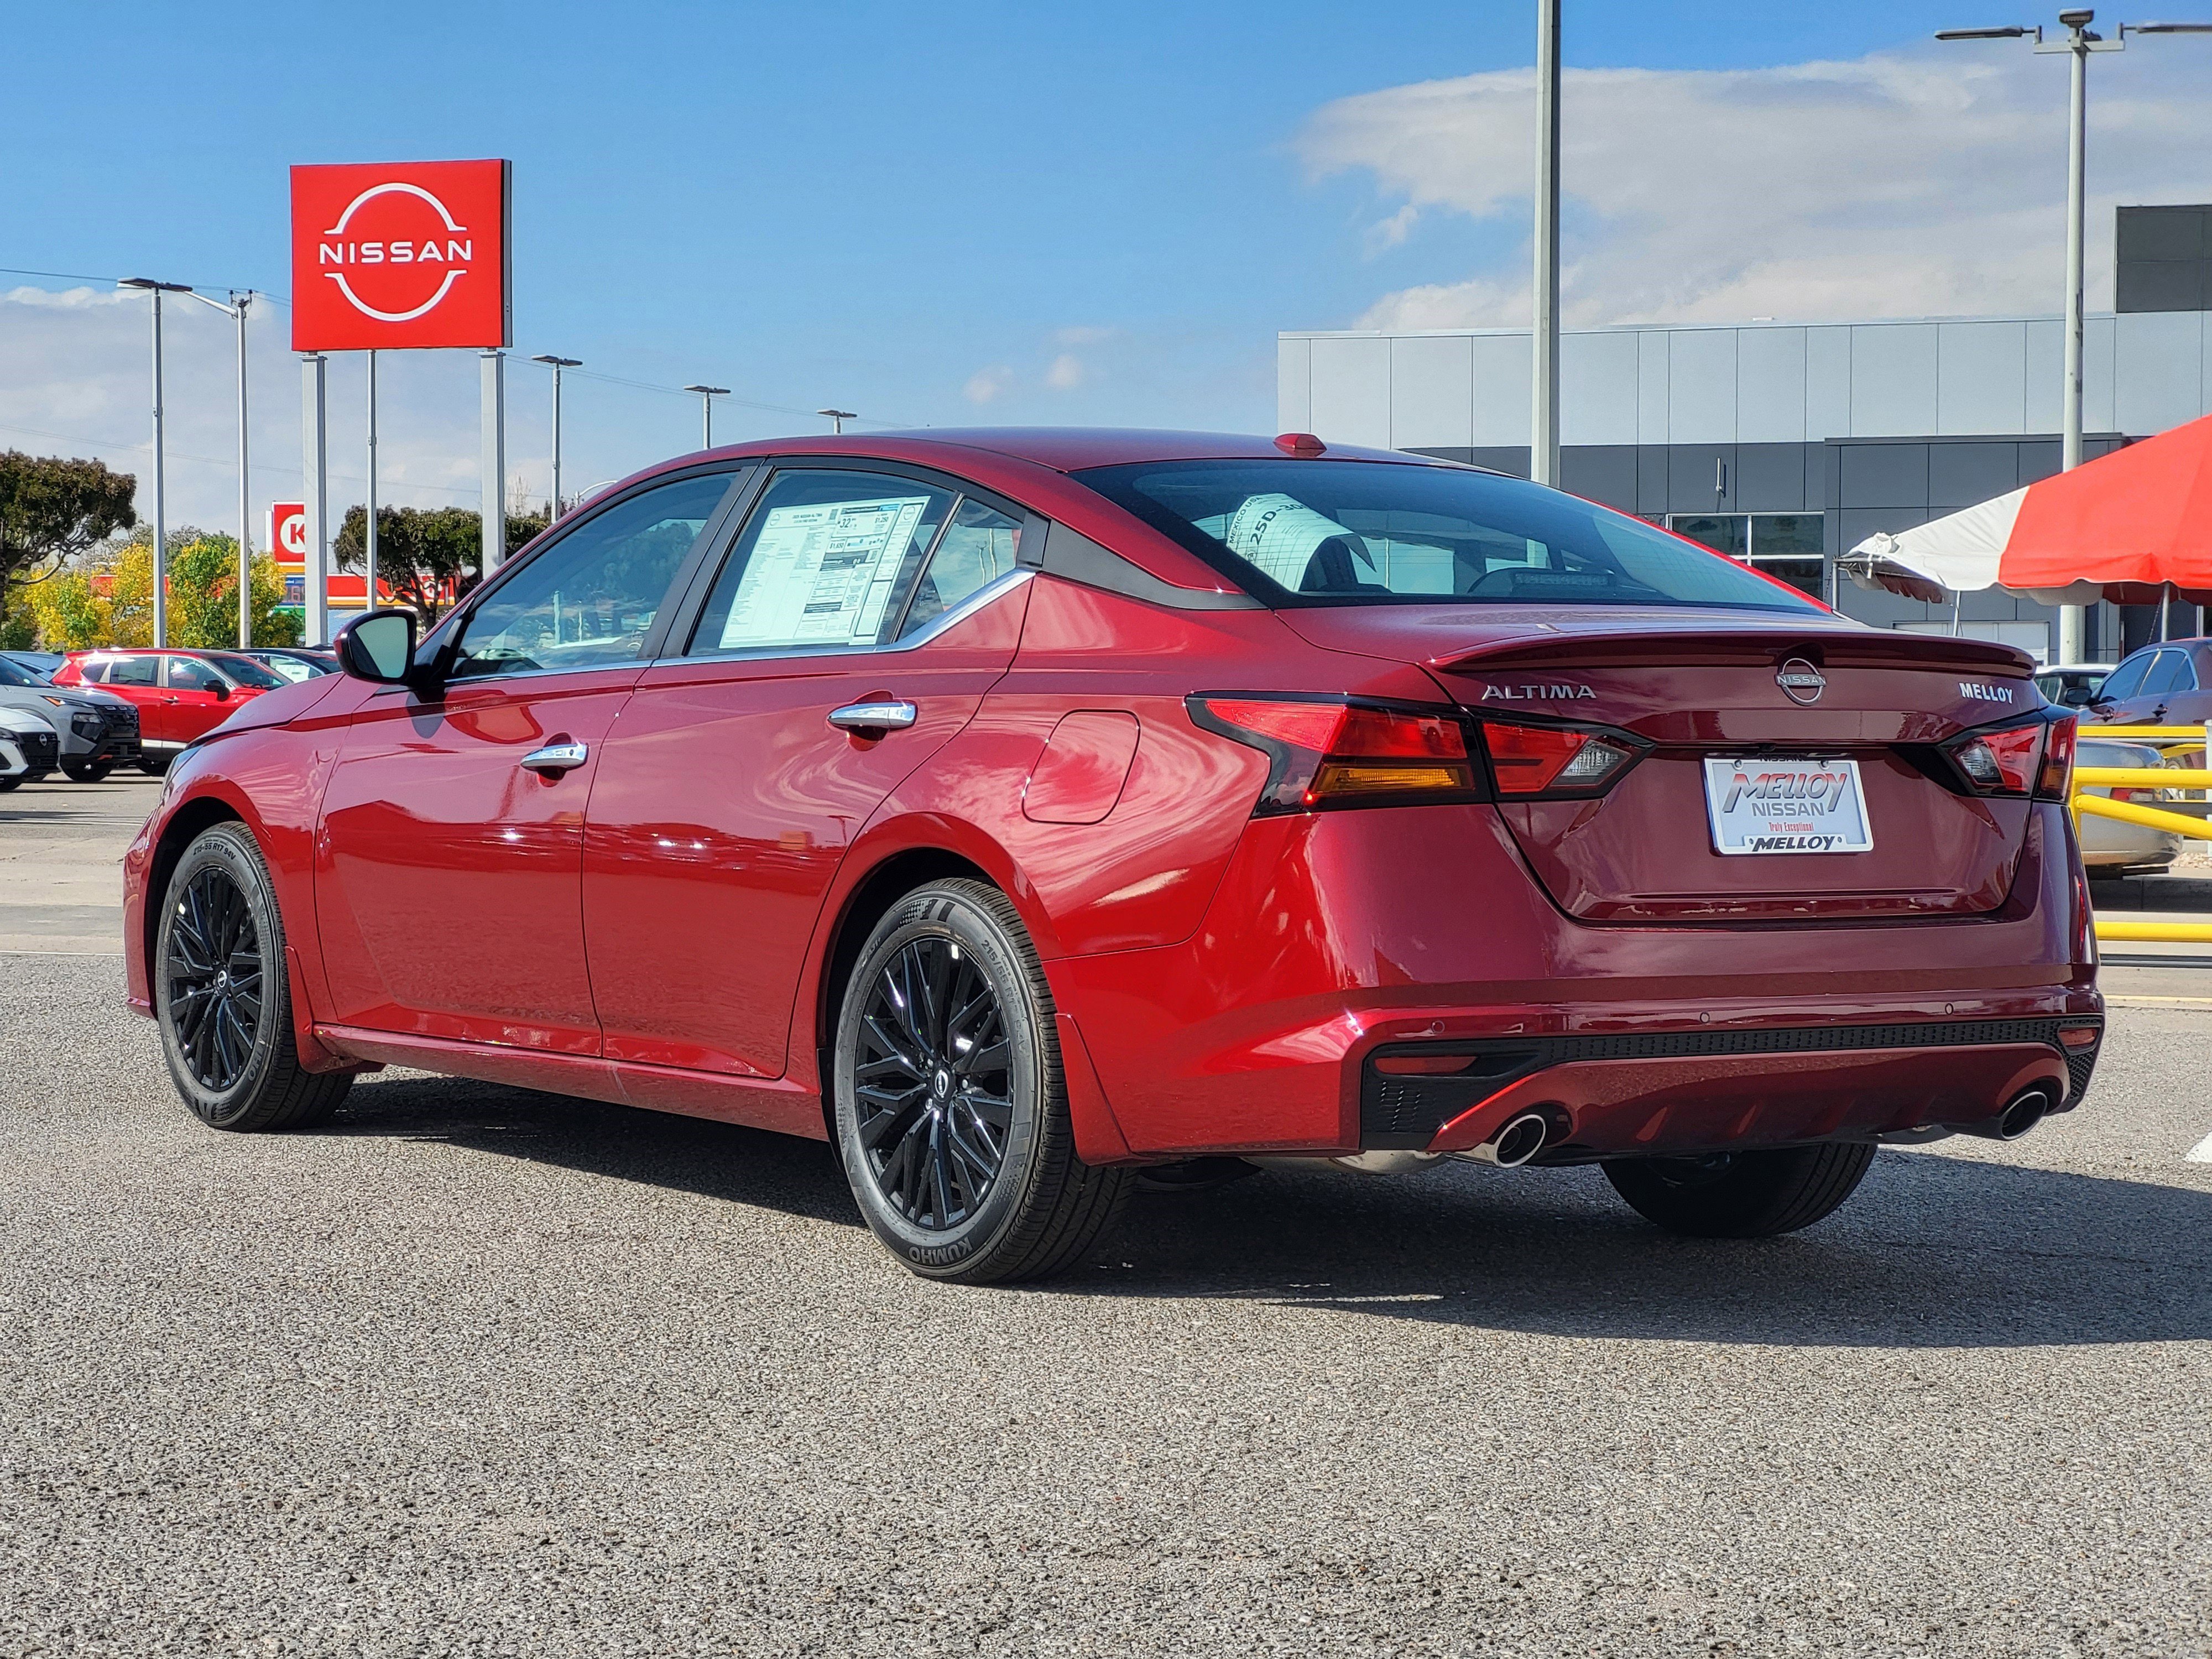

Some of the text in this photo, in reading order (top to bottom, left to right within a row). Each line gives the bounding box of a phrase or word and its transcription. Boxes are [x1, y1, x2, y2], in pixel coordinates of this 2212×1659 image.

[319, 239, 472, 265] NISSAN
[839, 518, 851, 528] 32
[1229, 509, 1246, 544] MEXICO
[290, 523, 305, 544] K
[1777, 676, 1826, 685] NISSAN
[1481, 685, 1597, 701] ALTIMA
[1959, 682, 2013, 704] MELLOY
[1759, 754, 1805, 762] NISSAN
[1722, 773, 1848, 813] MELLOY
[1752, 802, 1825, 817] NISSAN
[1768, 822, 1814, 833] Truly Exceptional
[212, 843, 225, 852] R17
[223, 847, 237, 860] 94V
[1752, 836, 1835, 852] MELLOY
[909, 1236, 973, 1265] KUMHO
